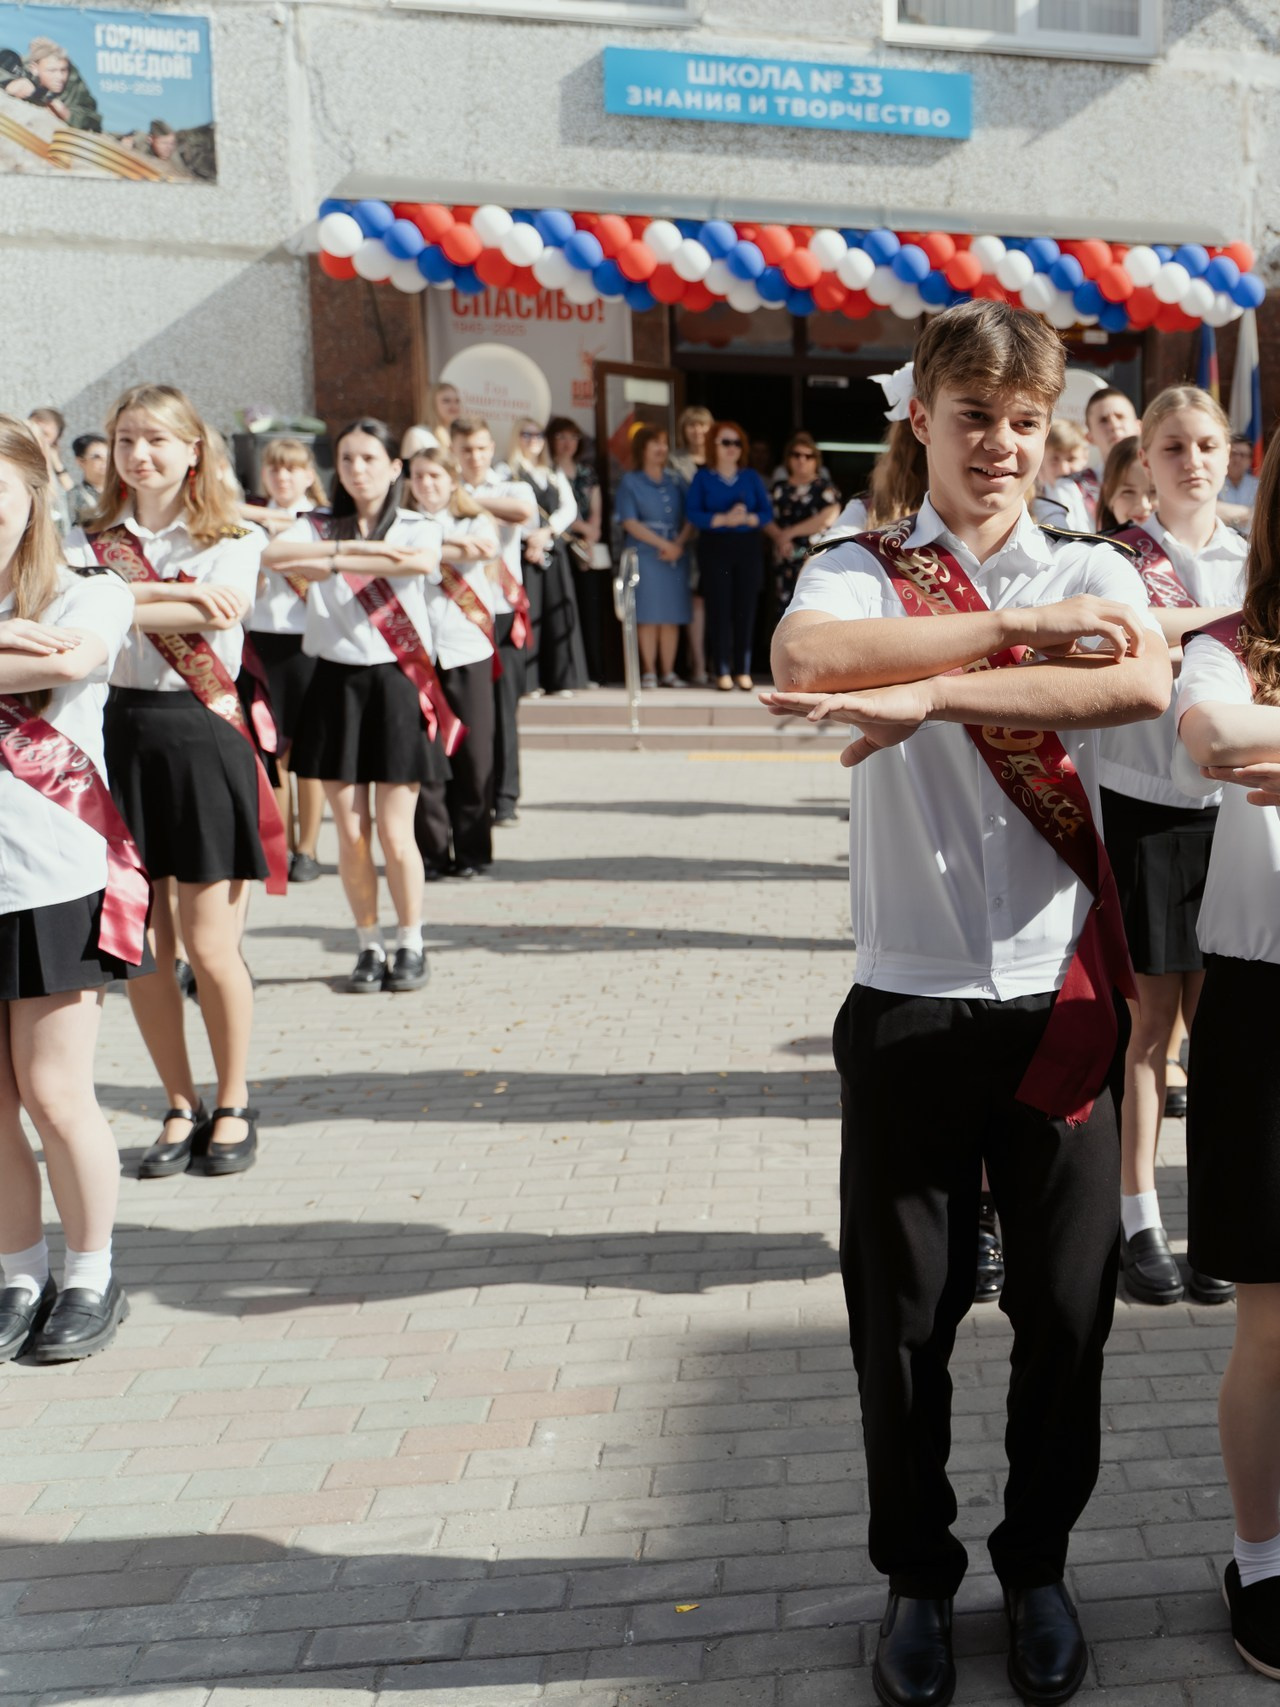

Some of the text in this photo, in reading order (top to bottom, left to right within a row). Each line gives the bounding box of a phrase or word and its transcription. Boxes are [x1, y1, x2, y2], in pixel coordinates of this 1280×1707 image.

[94, 23, 200, 54] ГОРДИМСЯ
[96, 49, 192, 80] ПОБЕДОЙ!
[687, 59, 883, 98] ШКОЛА № 33
[626, 85, 951, 128] ЗНАНИЯ И ТВОРЧЕСТВО
[176, 653, 214, 676] 9
[981, 724, 1045, 751] 9
